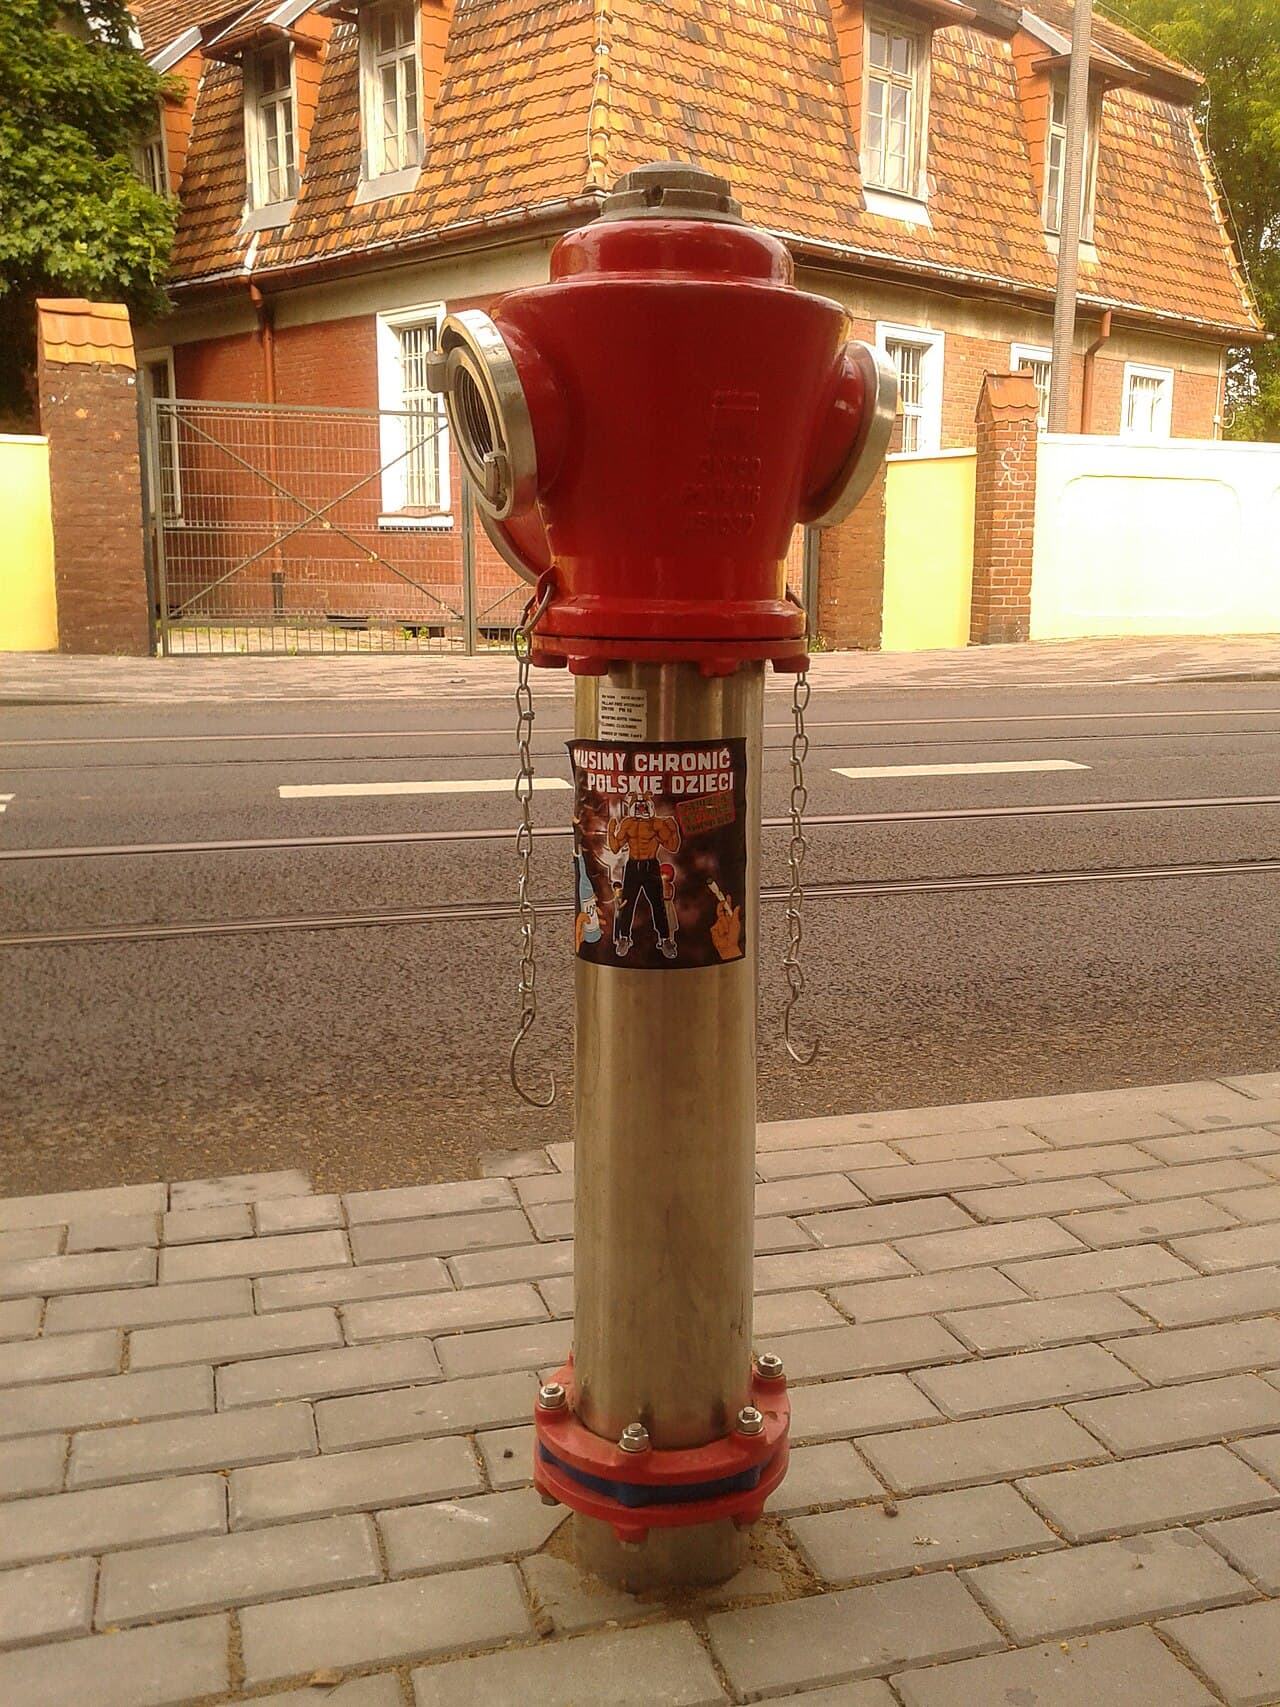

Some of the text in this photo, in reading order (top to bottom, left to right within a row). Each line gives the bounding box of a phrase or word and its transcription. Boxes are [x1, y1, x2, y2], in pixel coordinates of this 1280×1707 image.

[574, 748, 731, 772] MUSIMY CHRONIĆ
[587, 772, 734, 794] POLSKIE DZIECI
